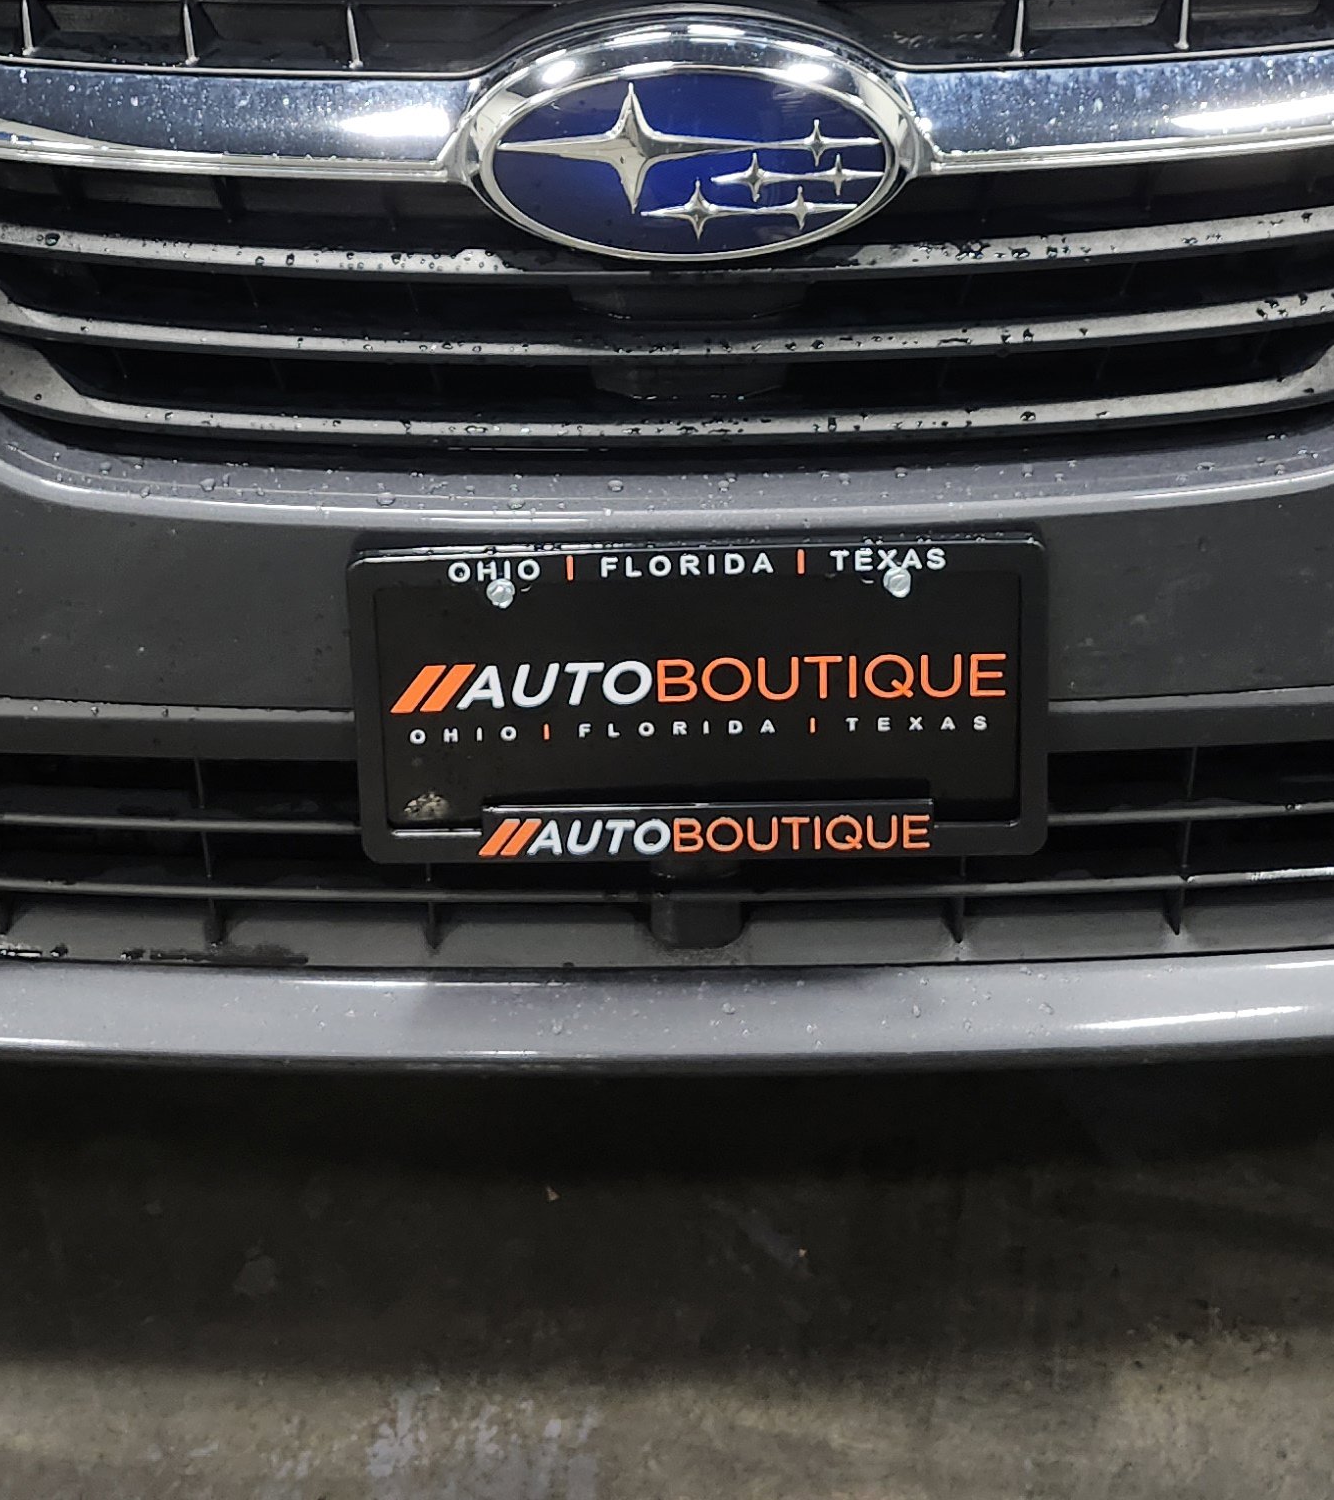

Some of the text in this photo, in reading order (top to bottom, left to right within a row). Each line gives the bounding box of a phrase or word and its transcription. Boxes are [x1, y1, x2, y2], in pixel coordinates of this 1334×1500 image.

[448, 547, 947, 583] OHIO FLORIDA TEXAS
[457, 653, 1007, 709] AUTOBOUTIQUE
[409, 714, 989, 745] OHIO FLORIDA TEXAS
[527, 813, 932, 857] AUTOBOUTIQUE
